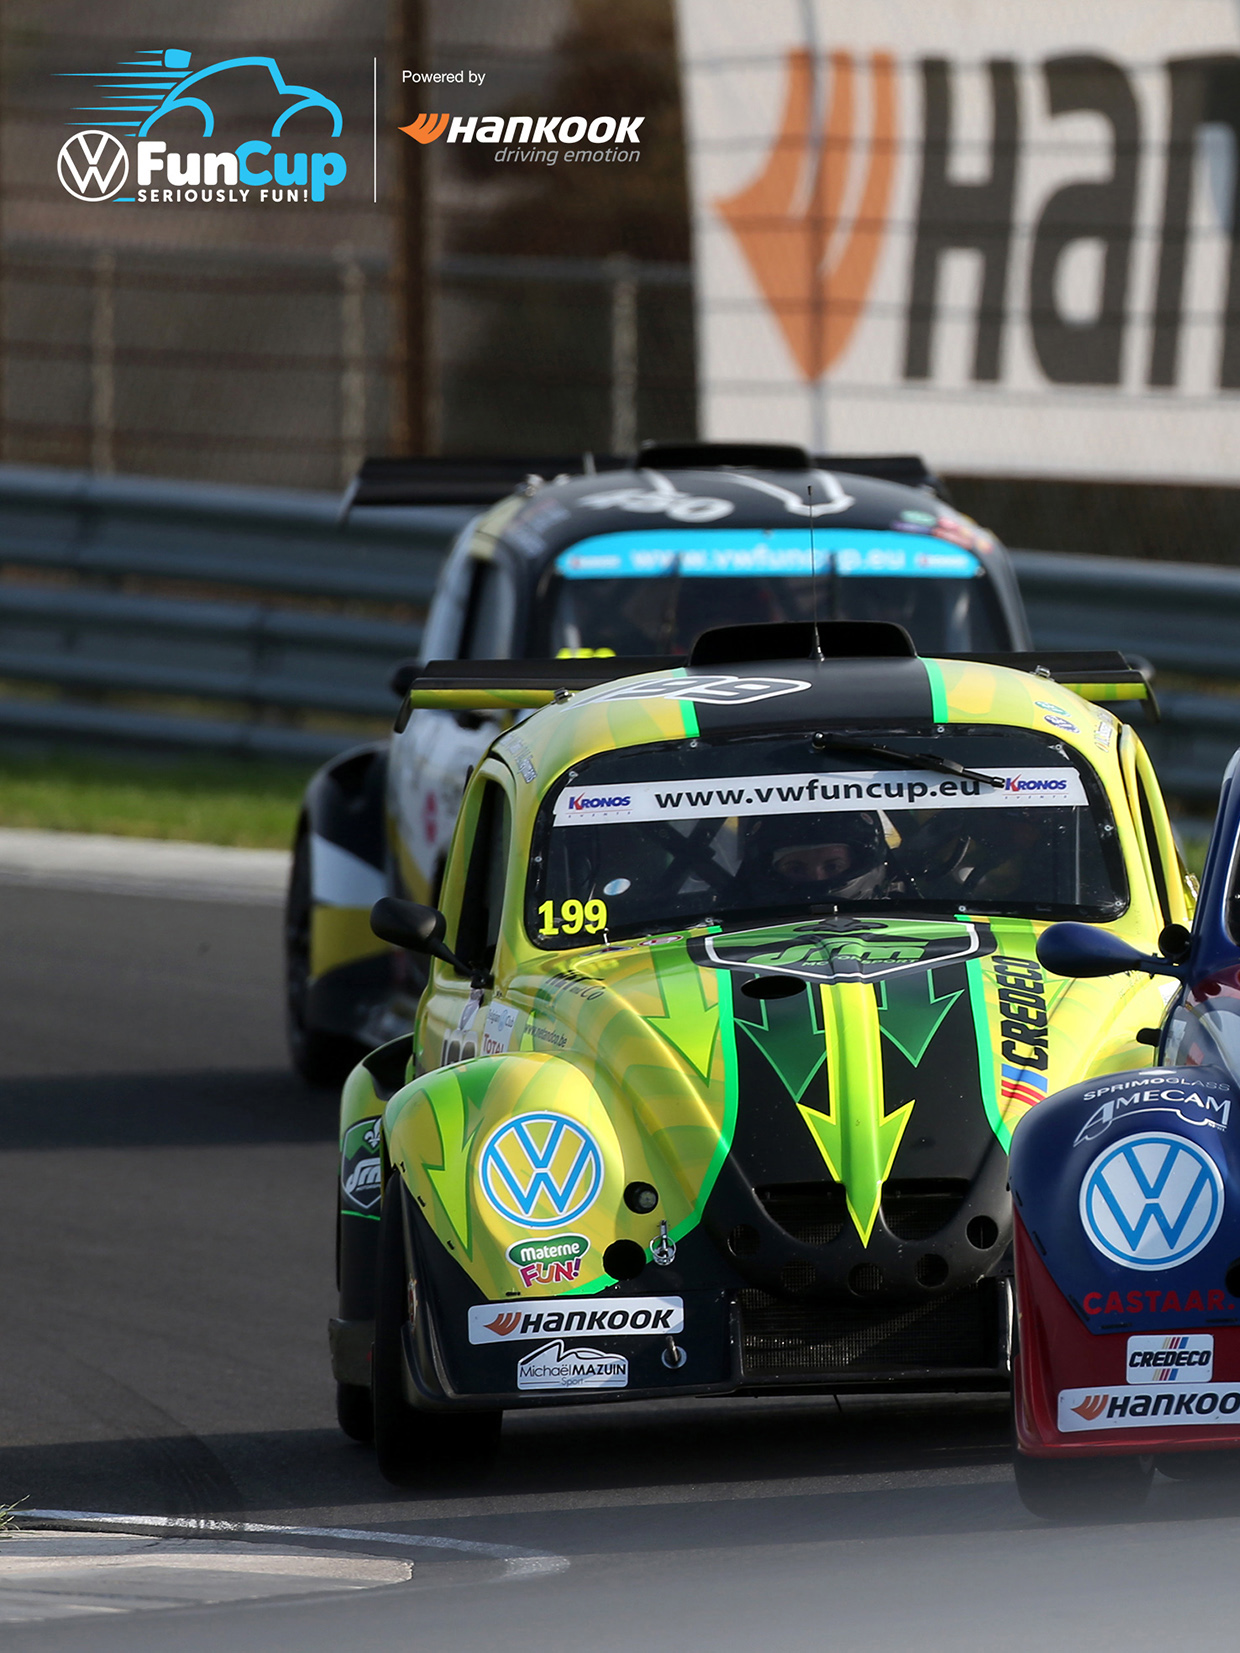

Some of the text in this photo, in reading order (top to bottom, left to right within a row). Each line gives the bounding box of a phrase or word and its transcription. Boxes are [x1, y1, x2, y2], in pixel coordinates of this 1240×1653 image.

[655, 779, 981, 809] www.vwfuncup.eu
[1005, 774, 1067, 792] KRONOS
[568, 793, 631, 811] KRONOS
[538, 899, 607, 936] 199
[991, 955, 1048, 1071] CREDECO
[1083, 1077, 1230, 1101] SPRIMOGLASS
[520, 1242, 580, 1262] Materne
[519, 1258, 582, 1288] FUN!
[1128, 1350, 1212, 1368] CREDECO
[560, 1376, 585, 1387] Sport
